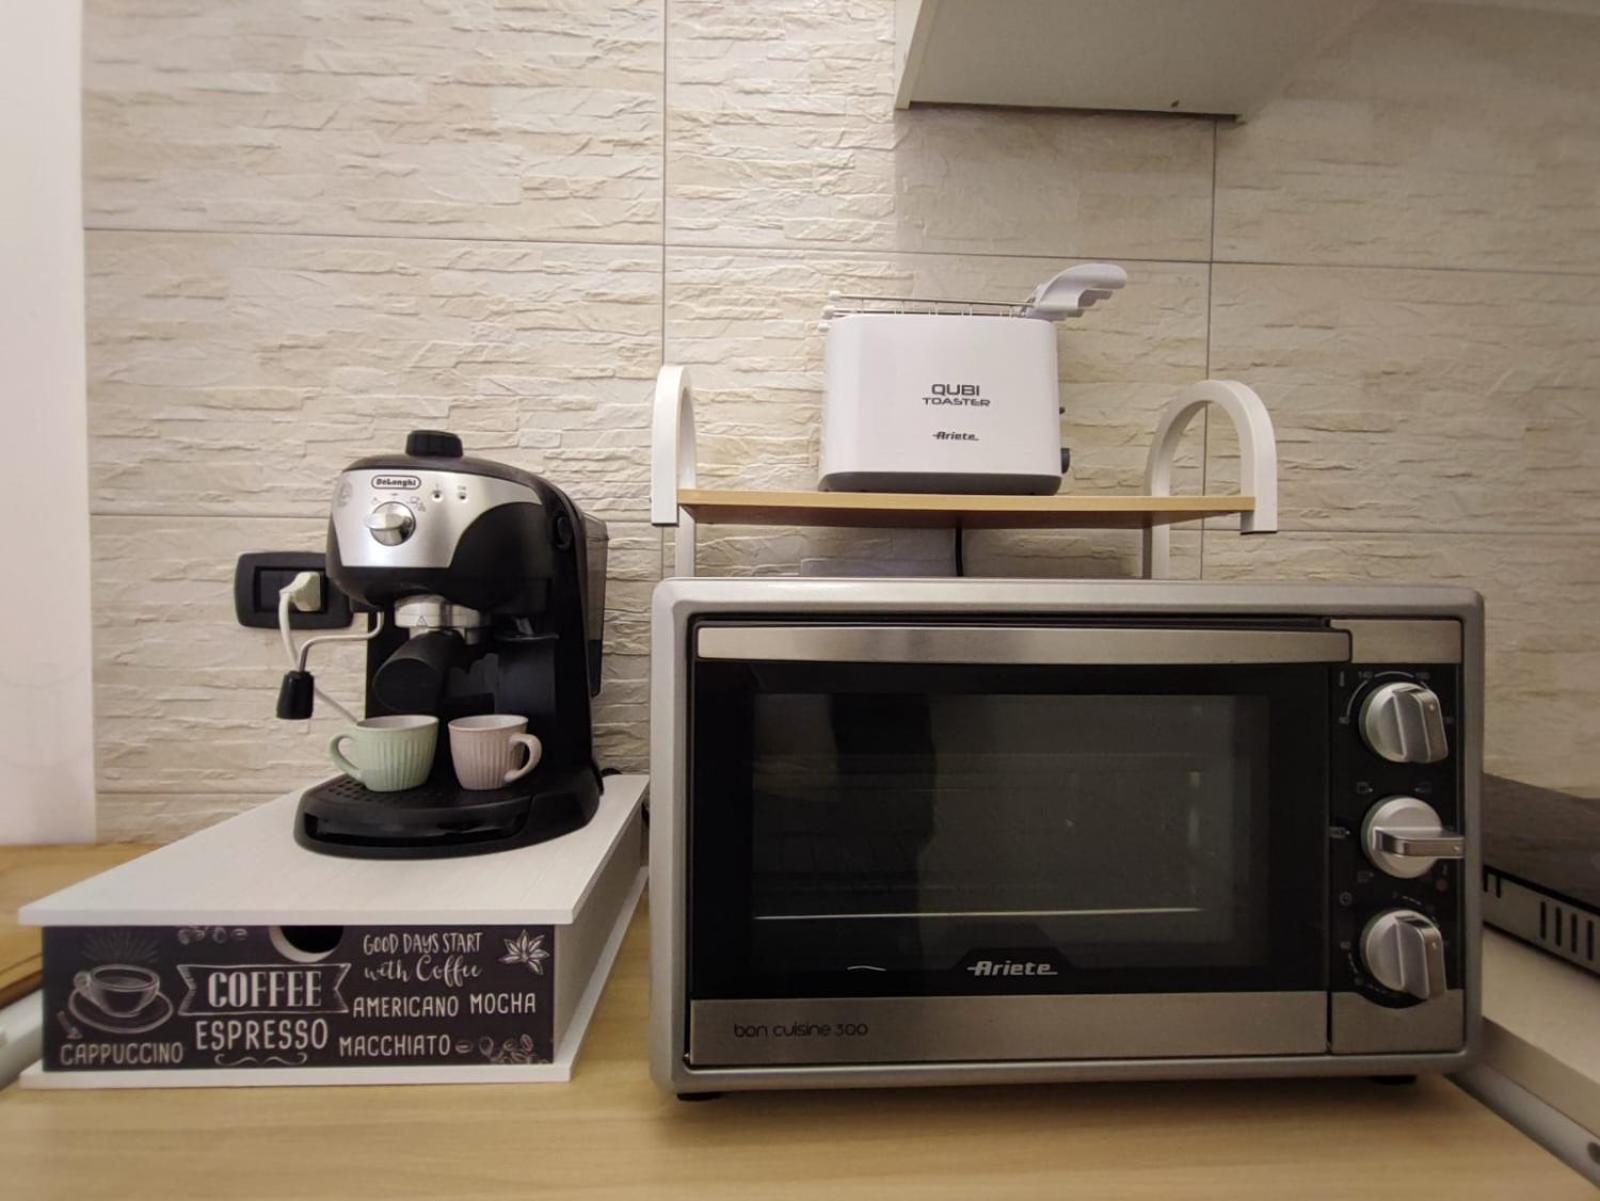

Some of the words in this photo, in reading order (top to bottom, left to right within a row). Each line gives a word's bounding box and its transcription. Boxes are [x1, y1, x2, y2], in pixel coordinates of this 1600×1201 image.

[931, 383, 980, 396] QUBI
[922, 397, 991, 407] TOASTER
[932, 430, 980, 441] Ariete
[376, 478, 416, 488] DeLonghi
[363, 934, 399, 956] GOOD
[403, 933, 439, 954] DAYS
[442, 932, 483, 953] START
[364, 960, 410, 982] with
[416, 955, 483, 988] Coffee
[966, 960, 1058, 977] Ariete
[208, 970, 322, 1008] COFFEE
[353, 996, 459, 1018] AMERICANO
[470, 992, 536, 1014] MOCHA
[196, 1018, 328, 1051] ESPRESSO
[734, 1023, 768, 1038] bon
[772, 1021, 831, 1037] cuisine
[835, 1023, 869, 1037] 300
[60, 1042, 184, 1065] CAPPUCCINO
[339, 1034, 450, 1057] MACCHIATO
